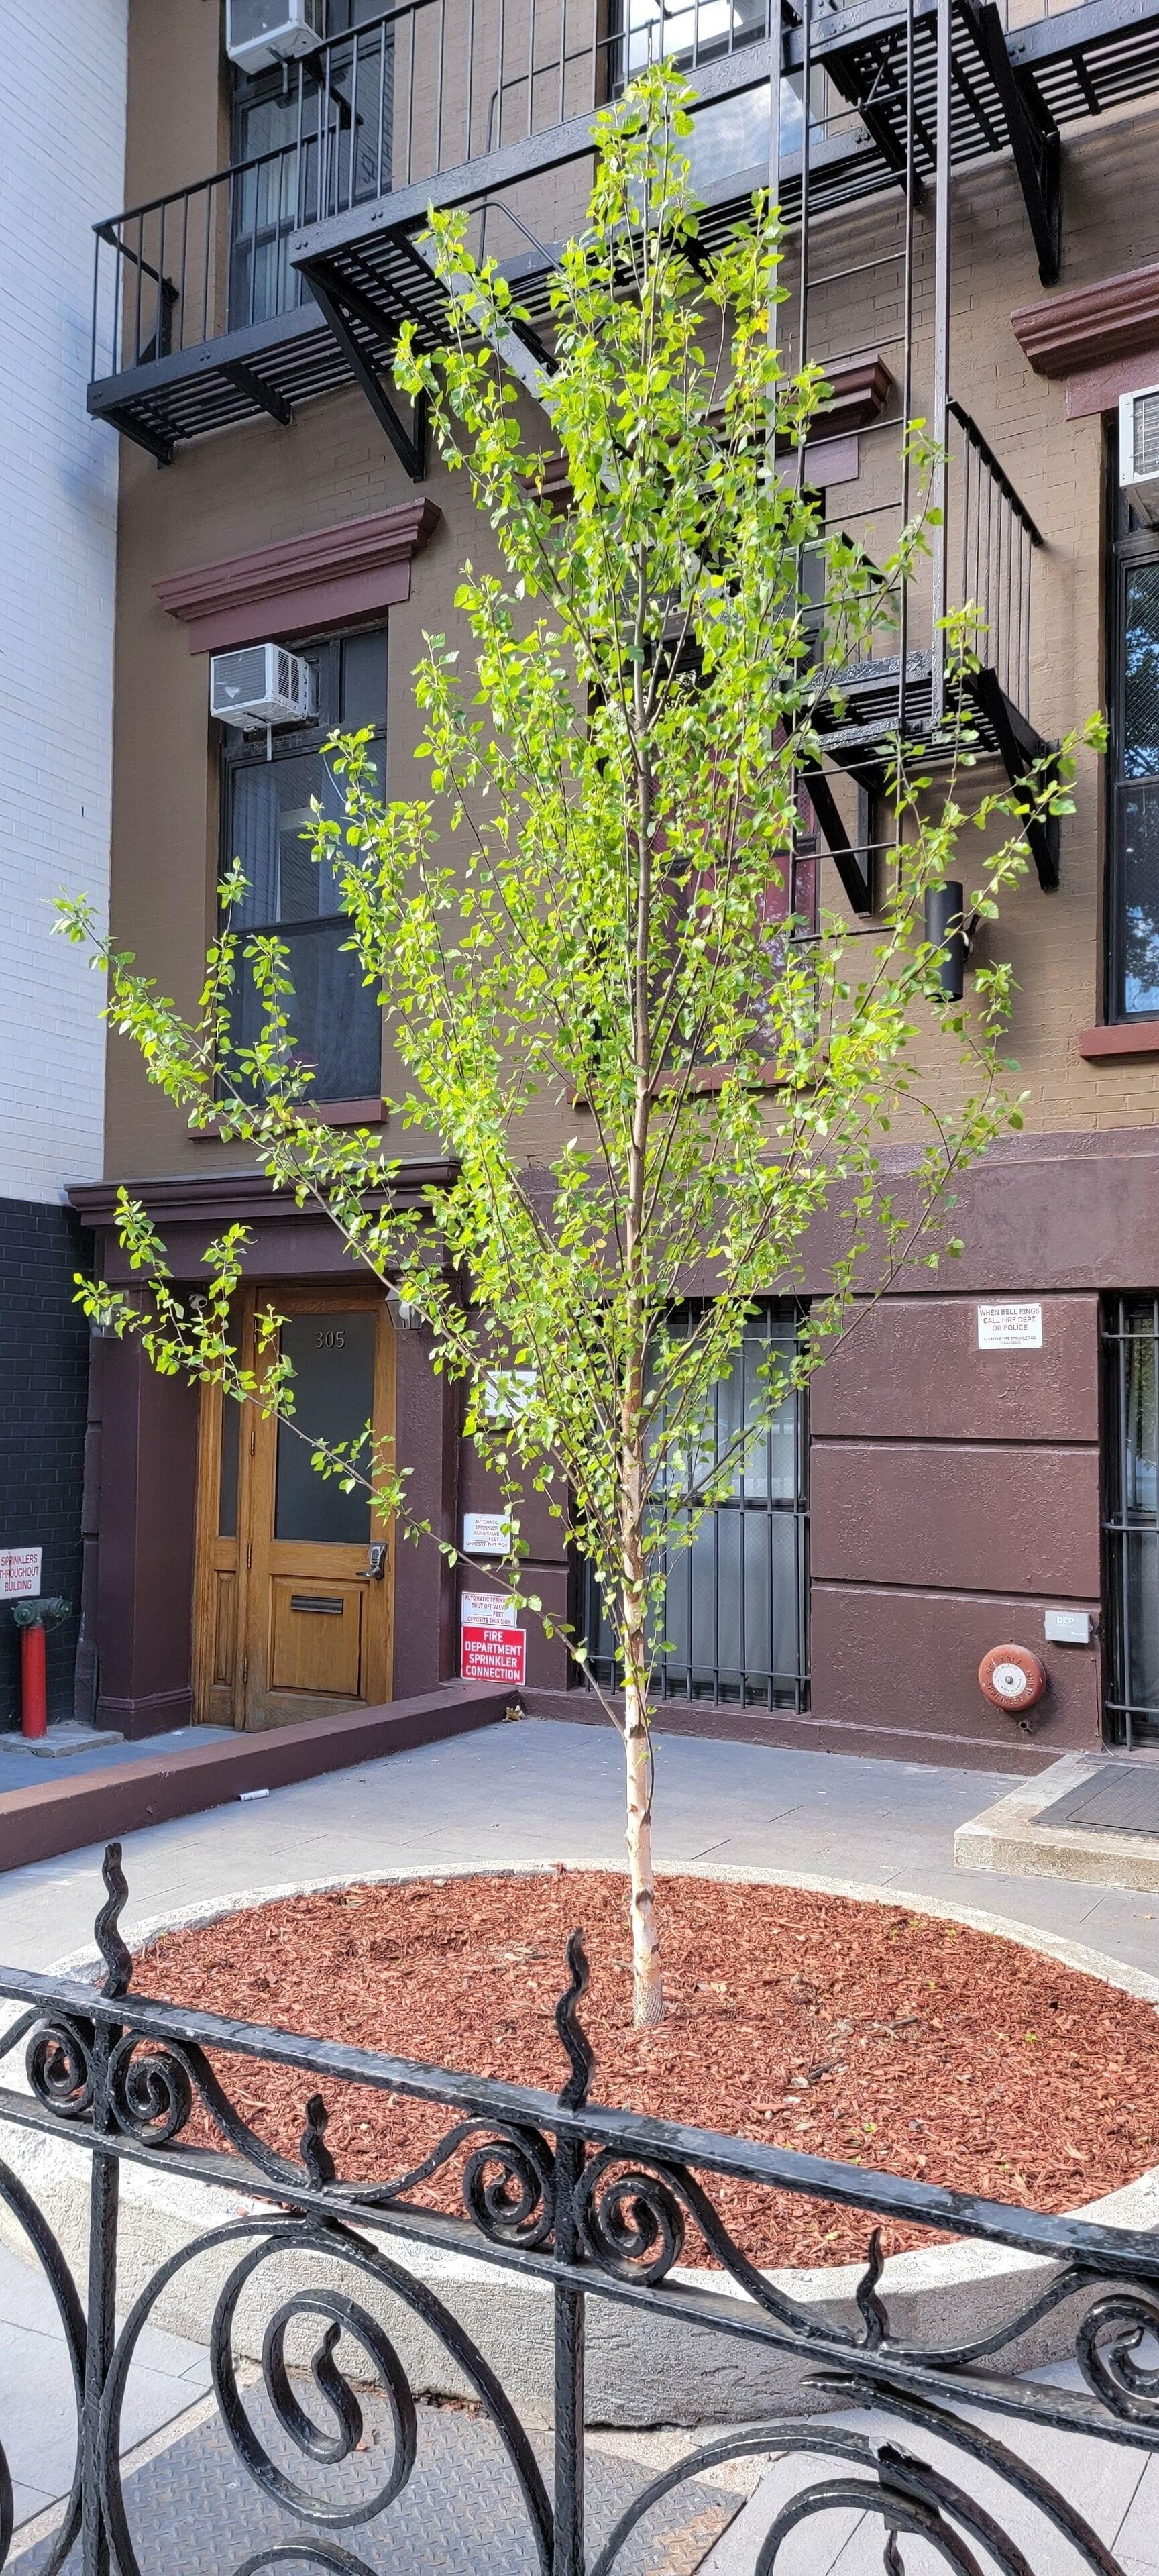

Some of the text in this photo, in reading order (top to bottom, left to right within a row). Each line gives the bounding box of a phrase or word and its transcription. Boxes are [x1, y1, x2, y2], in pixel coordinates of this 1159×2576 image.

[315, 1331, 345, 1348] 305
[1, 1554, 38, 1566] SPRINKLERS
[0, 1566, 39, 1579] THROUGHOUT
[5, 1579, 32, 1592] BUILDING
[484, 1630, 504, 1642] FIRE
[465, 1641, 522, 1656] DEPARTMENT
[469, 1653, 518, 1668] SPRINKLER
[465, 1665, 520, 1681] CONNECTION
